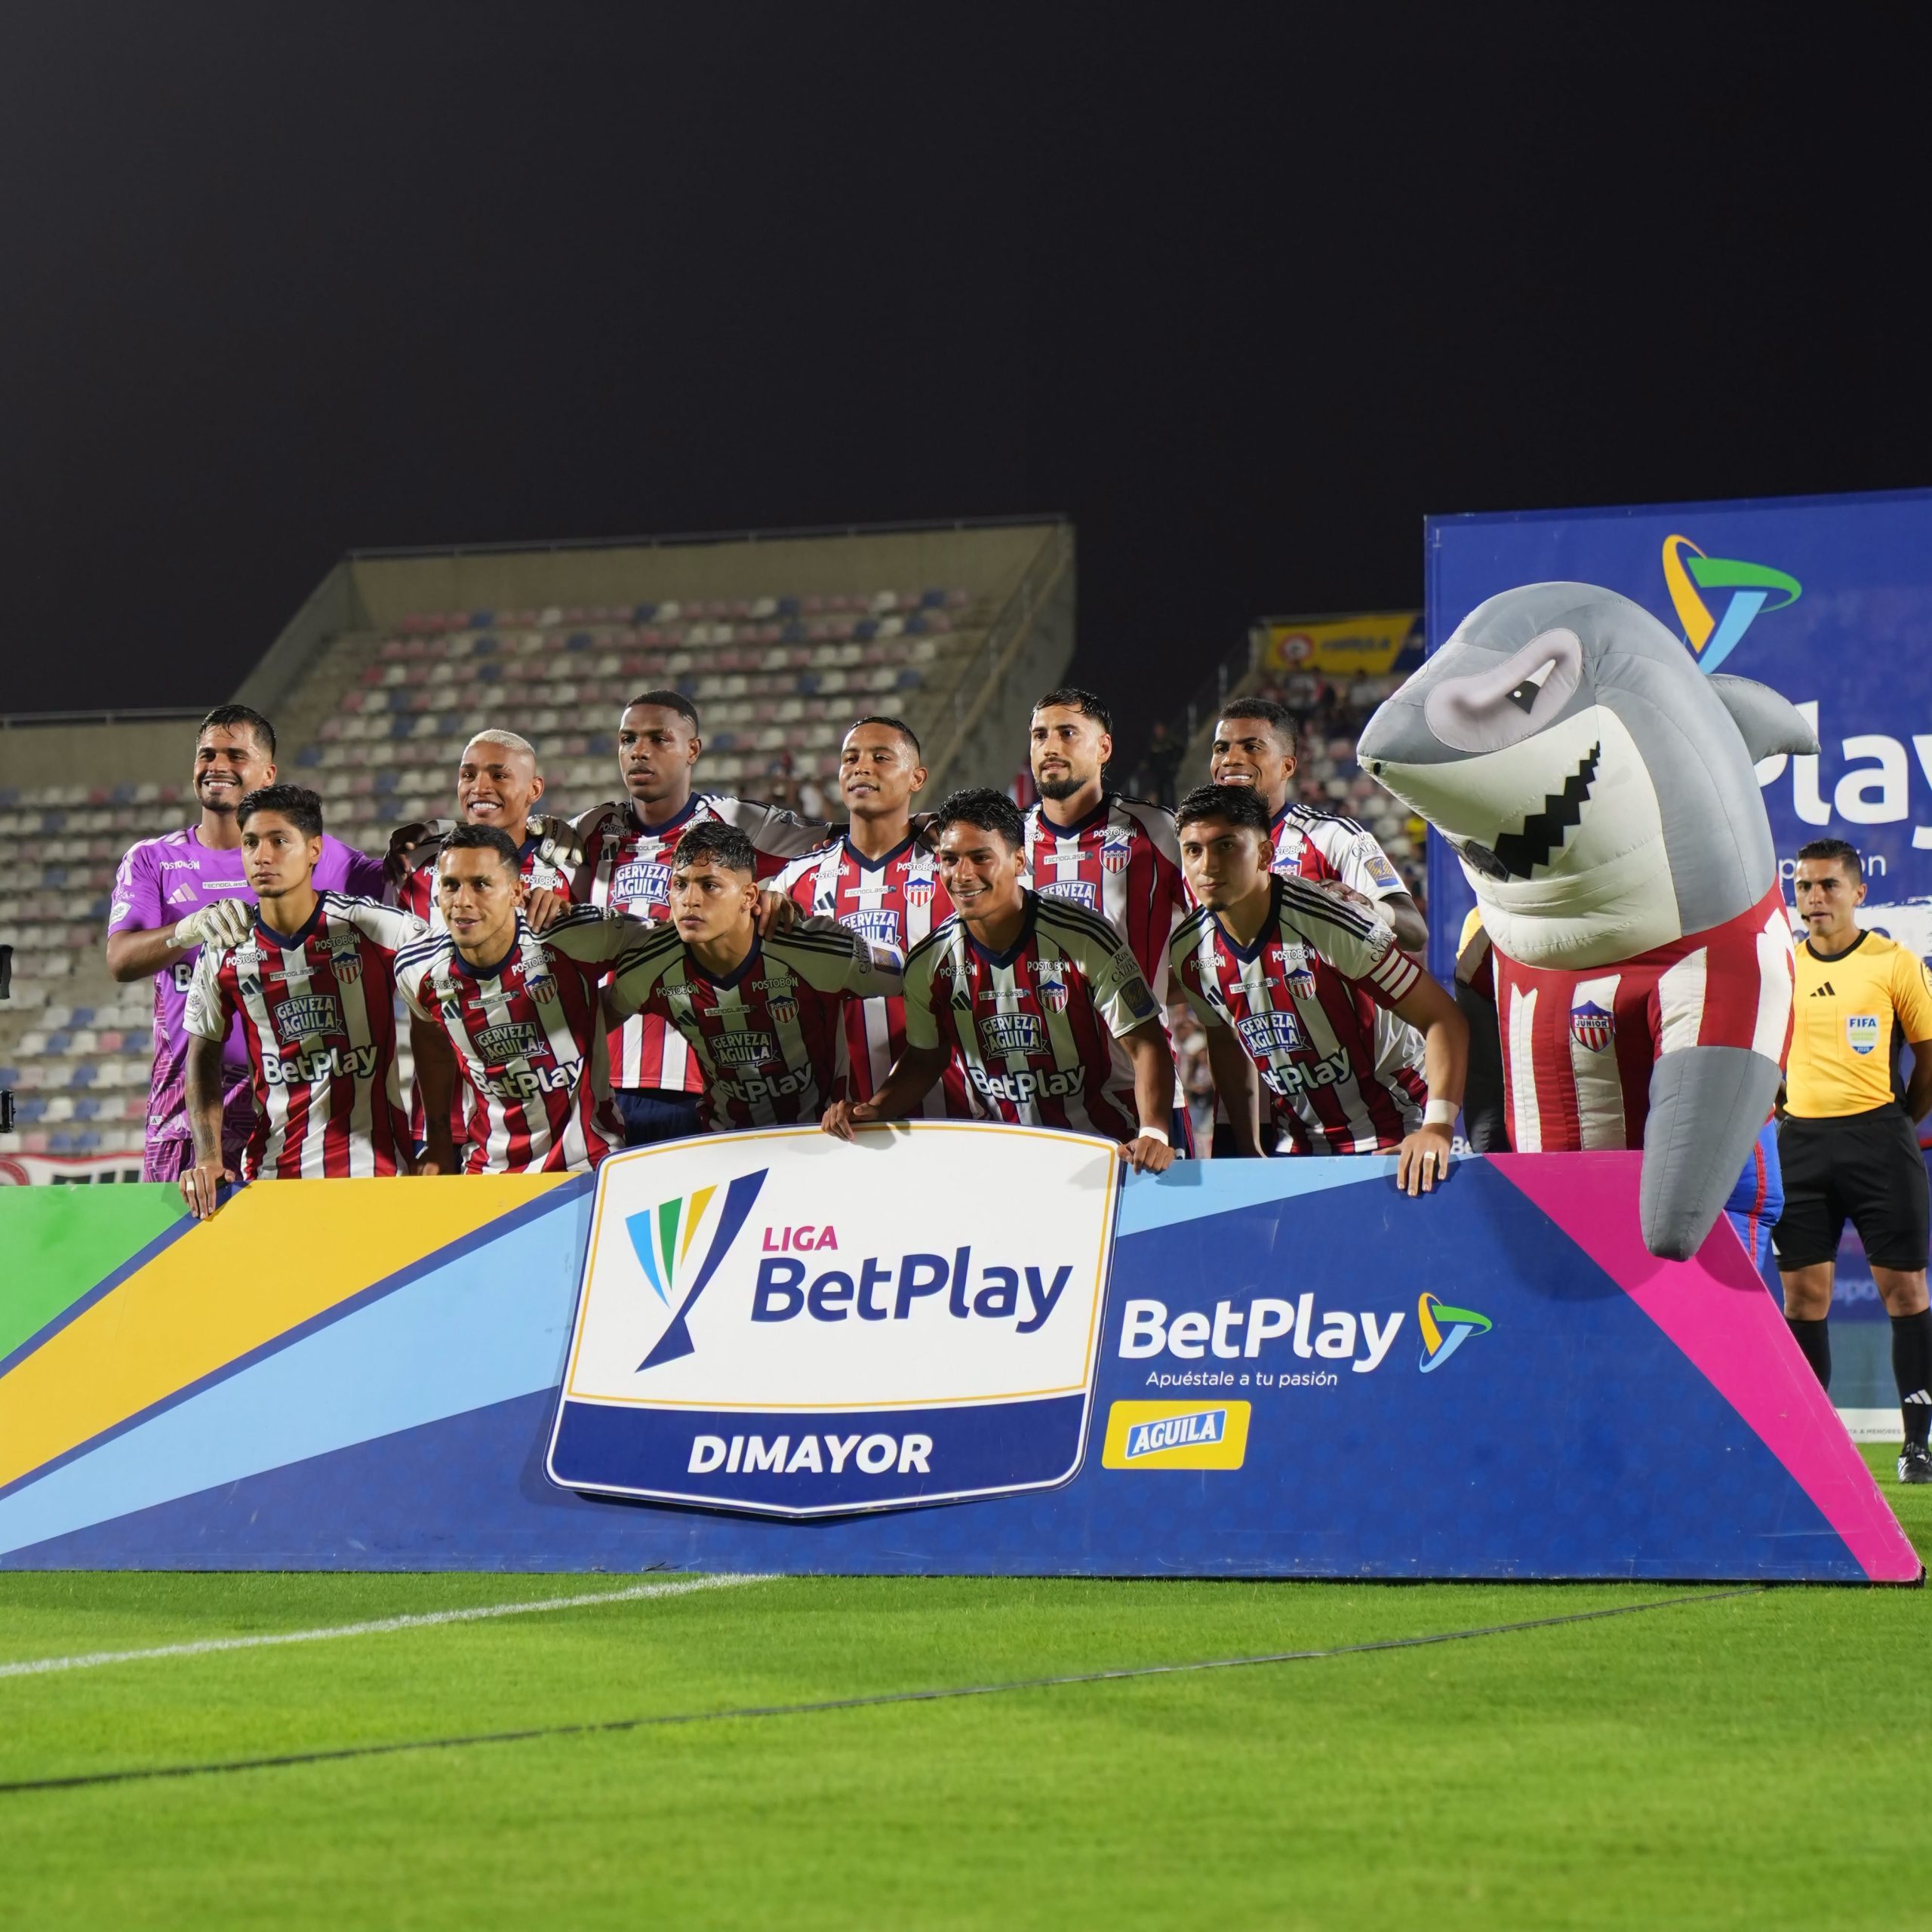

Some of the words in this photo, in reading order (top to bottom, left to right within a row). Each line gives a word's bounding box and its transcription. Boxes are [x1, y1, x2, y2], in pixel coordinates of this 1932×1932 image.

[617, 878, 666, 898] AGUILA
[282, 1014, 335, 1036] AGUILA
[1849, 1018, 1877, 1028] FIFA
[485, 1037, 538, 1060] AGUILA
[989, 1030, 1039, 1052] AGUILA
[1248, 1027, 1299, 1052] AGUILA
[261, 1045, 378, 1084] BetPlay
[719, 1046, 770, 1064] AGUILA
[469, 1057, 585, 1098] BetPlay
[717, 1062, 813, 1103] etPlay
[968, 1065, 1086, 1102] BetPlay
[761, 1225, 838, 1252] LIGA
[750, 1245, 1074, 1334] BetPlay
[1118, 1292, 1405, 1373] BetPlay
[1146, 1371, 1235, 1387] Apuéstale
[1239, 1375, 1251, 1386] a
[1256, 1373, 1273, 1386] tu
[1278, 1371, 1338, 1387] pasión
[1131, 1414, 1217, 1455] AGUILA
[688, 1434, 934, 1474] DIMAYOR
